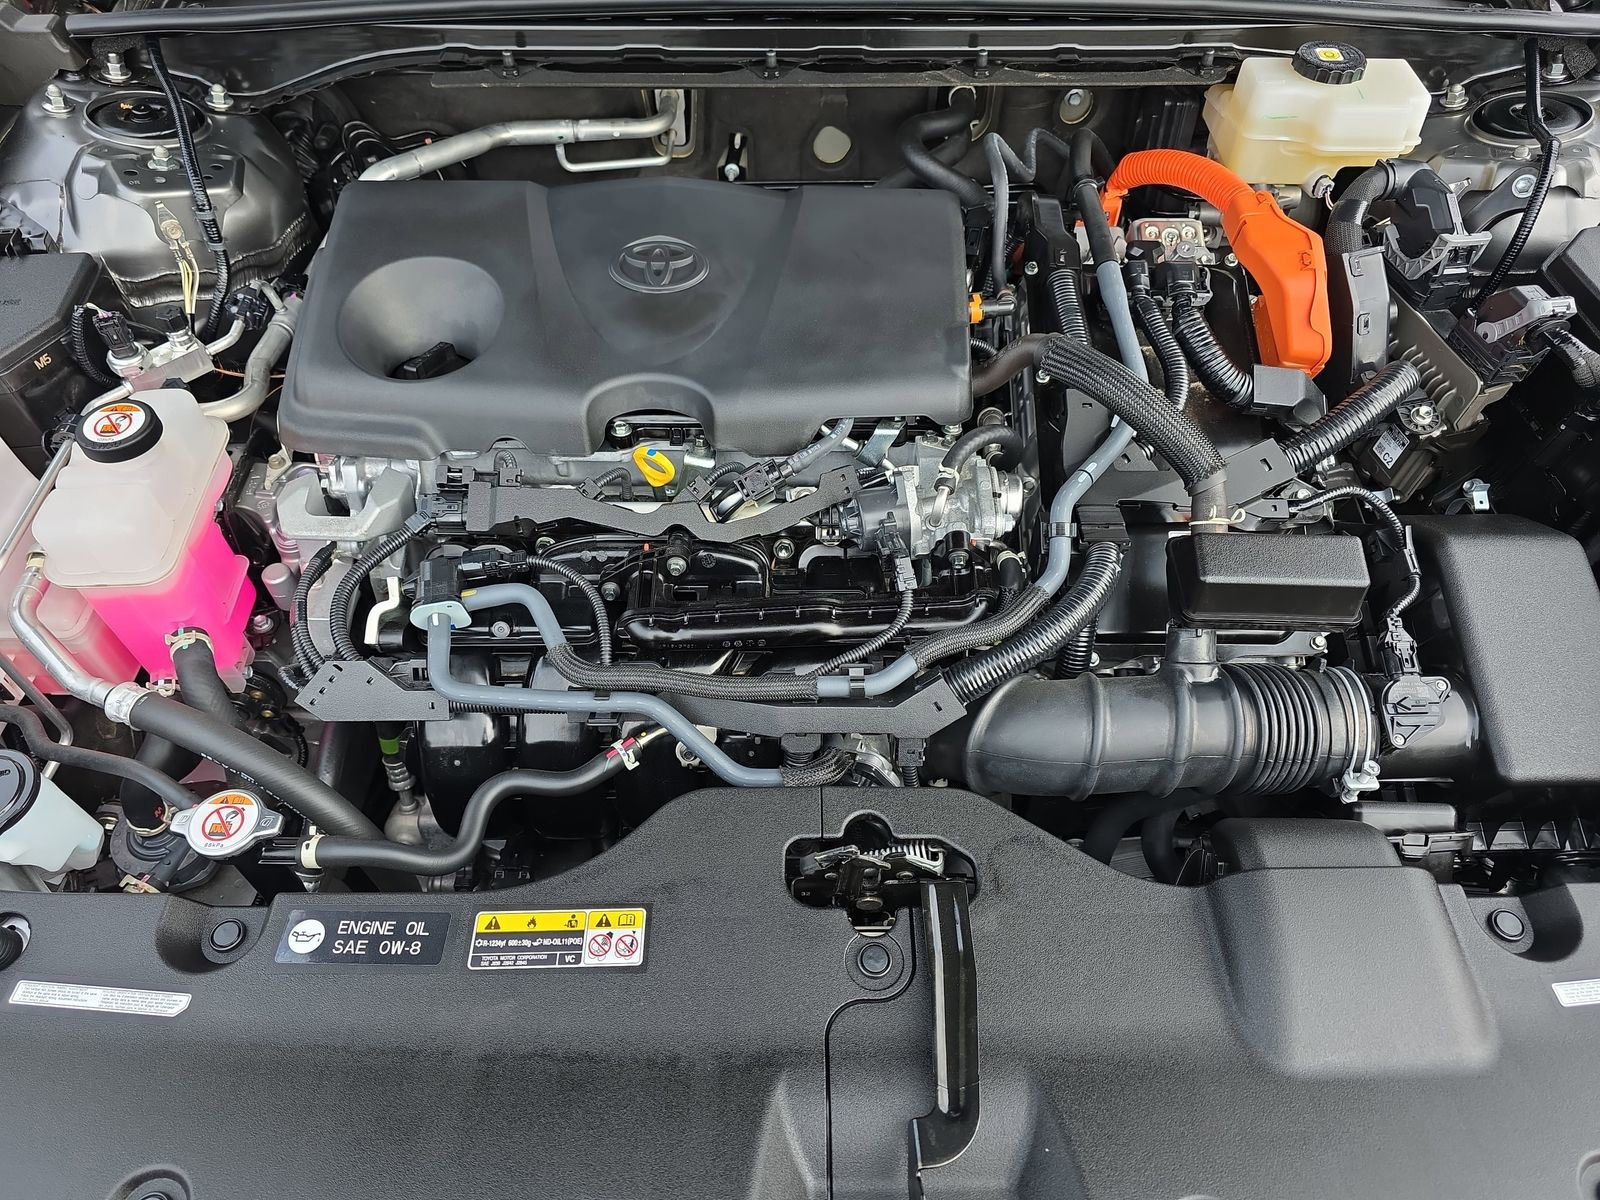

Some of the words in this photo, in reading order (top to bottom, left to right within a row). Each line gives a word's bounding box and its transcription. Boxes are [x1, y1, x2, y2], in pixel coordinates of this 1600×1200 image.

[33, 352, 52, 370] M5
[1383, 452, 1393, 466] C2
[337, 920, 397, 935] ENGINE
[405, 921, 430, 936] OIL
[332, 940, 369, 955] SAE
[564, 955, 576, 963] VC
